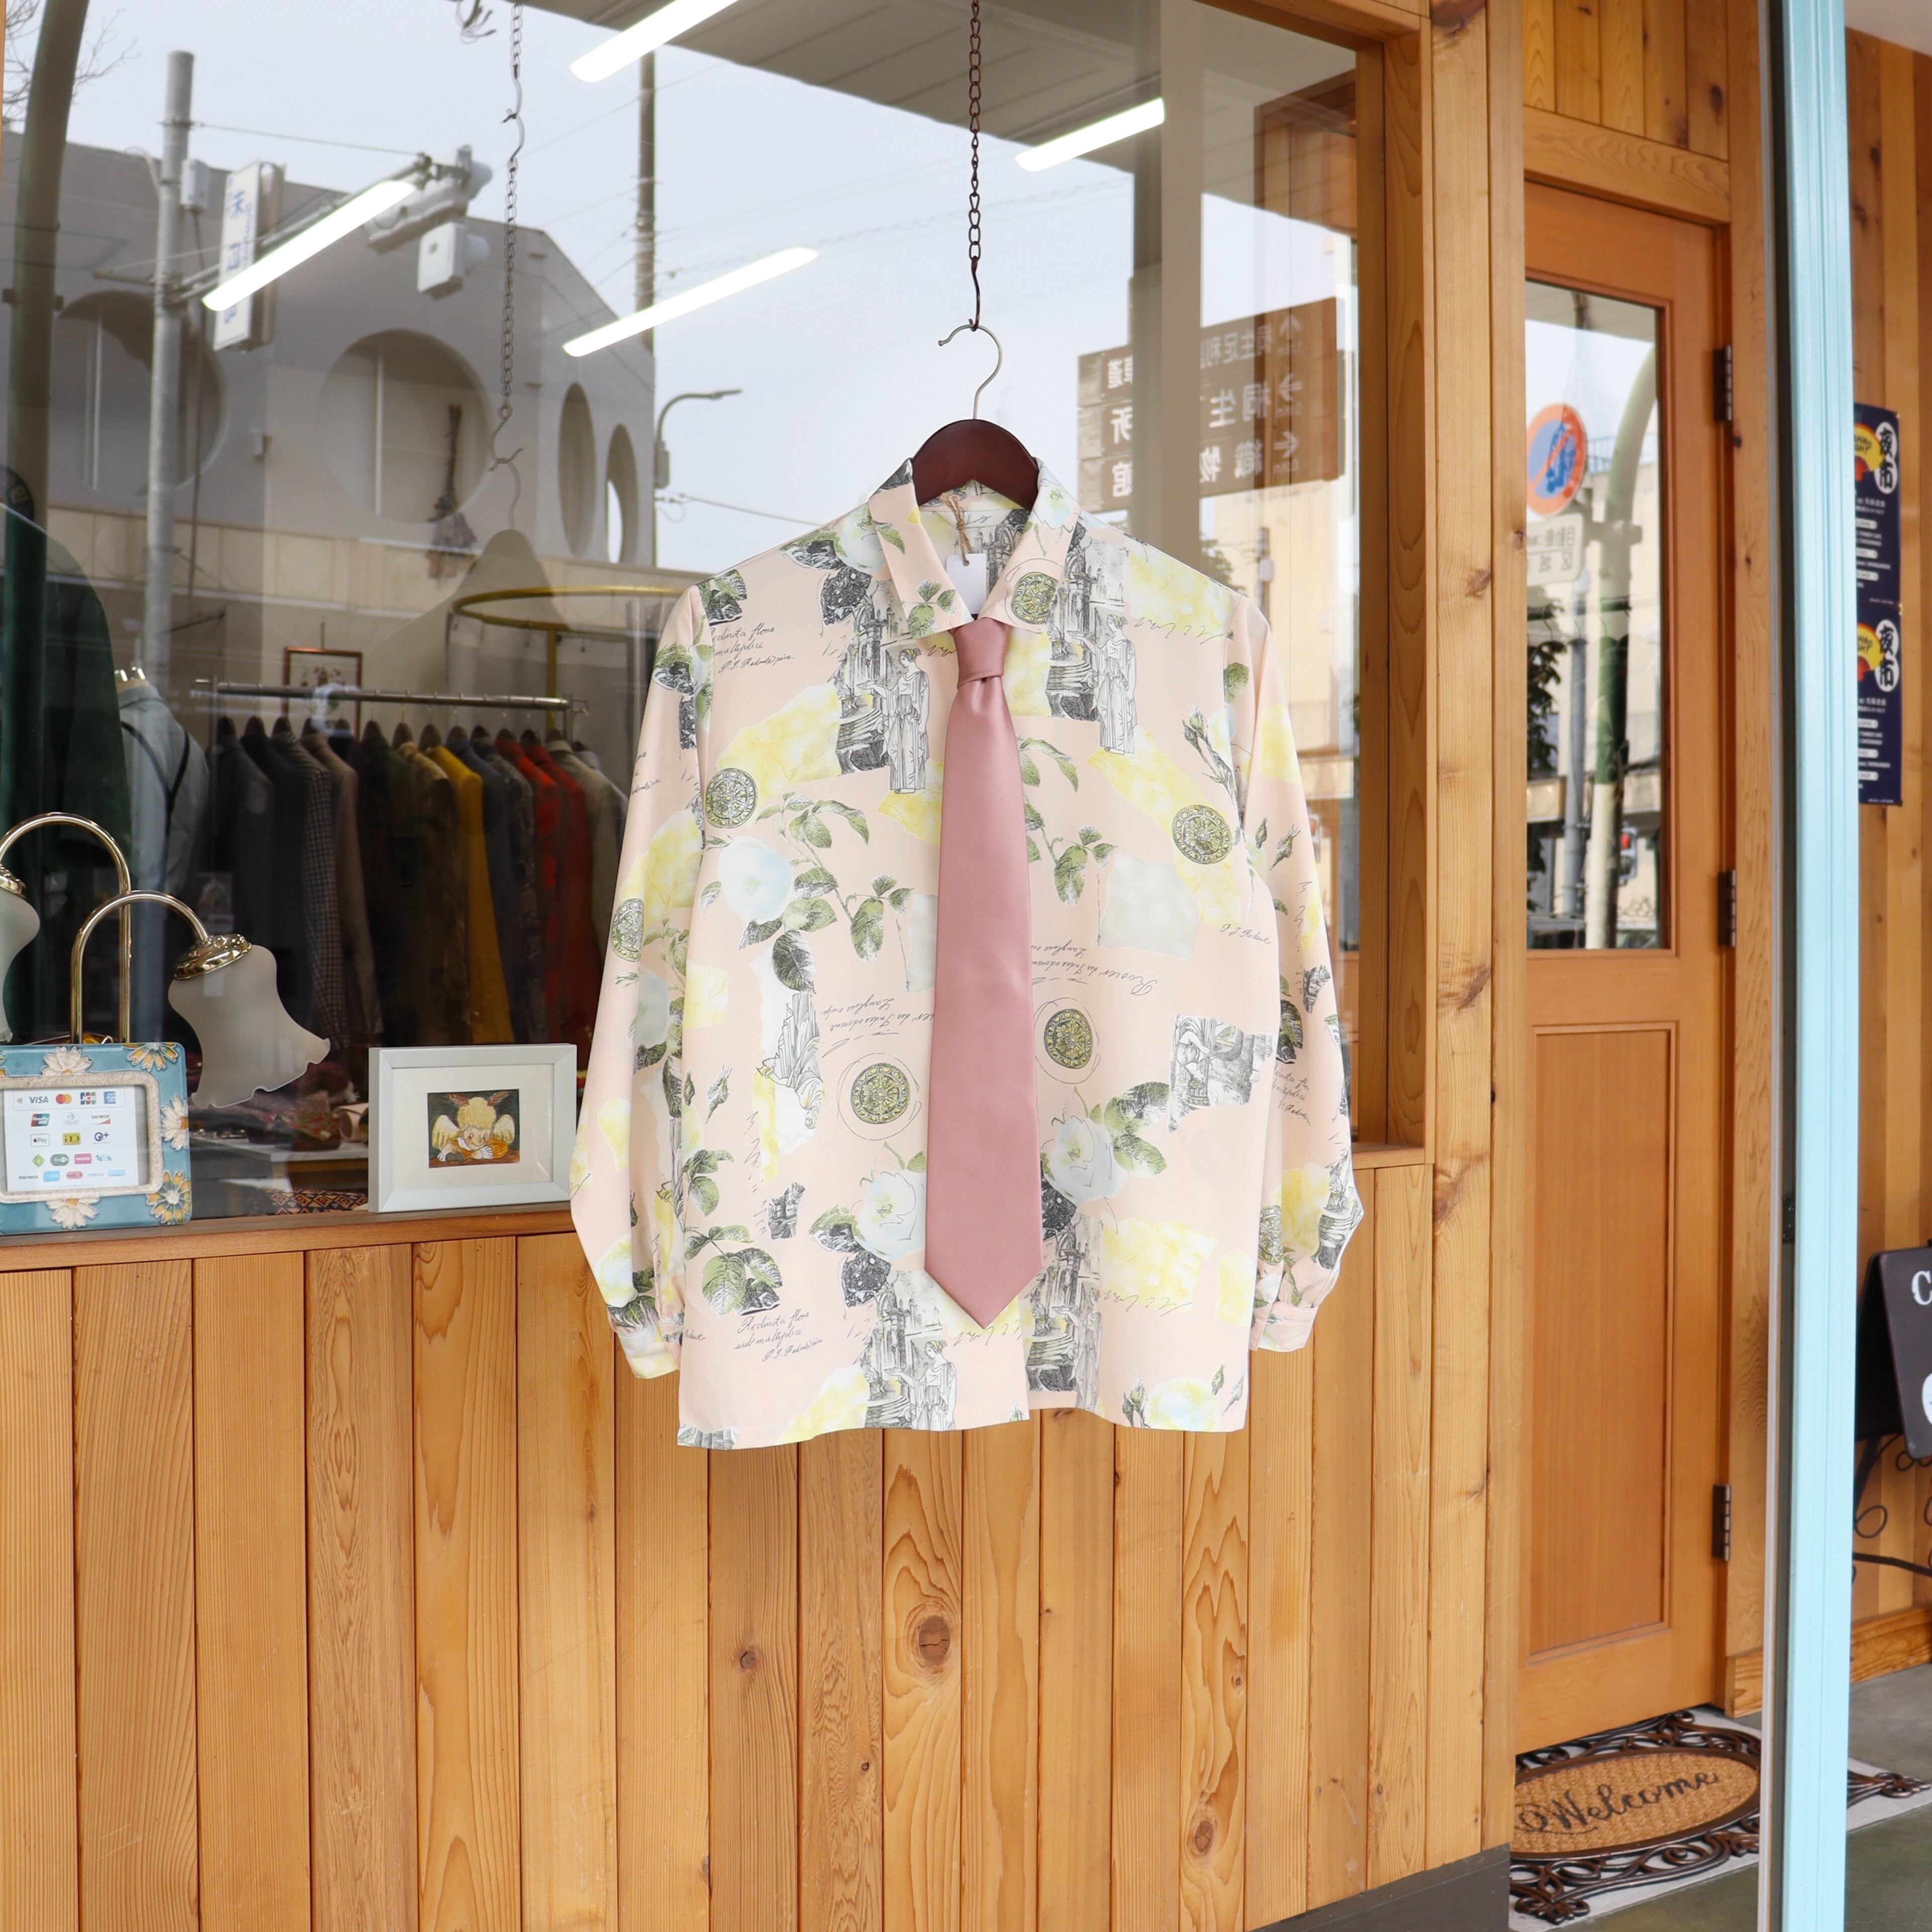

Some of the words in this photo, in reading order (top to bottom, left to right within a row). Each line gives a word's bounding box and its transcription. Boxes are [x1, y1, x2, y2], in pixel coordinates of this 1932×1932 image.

[29, 1096, 49, 1104] VISA
[64, 1135, 80, 1143] iD
[1515, 1770, 1719, 1835] Welcome
